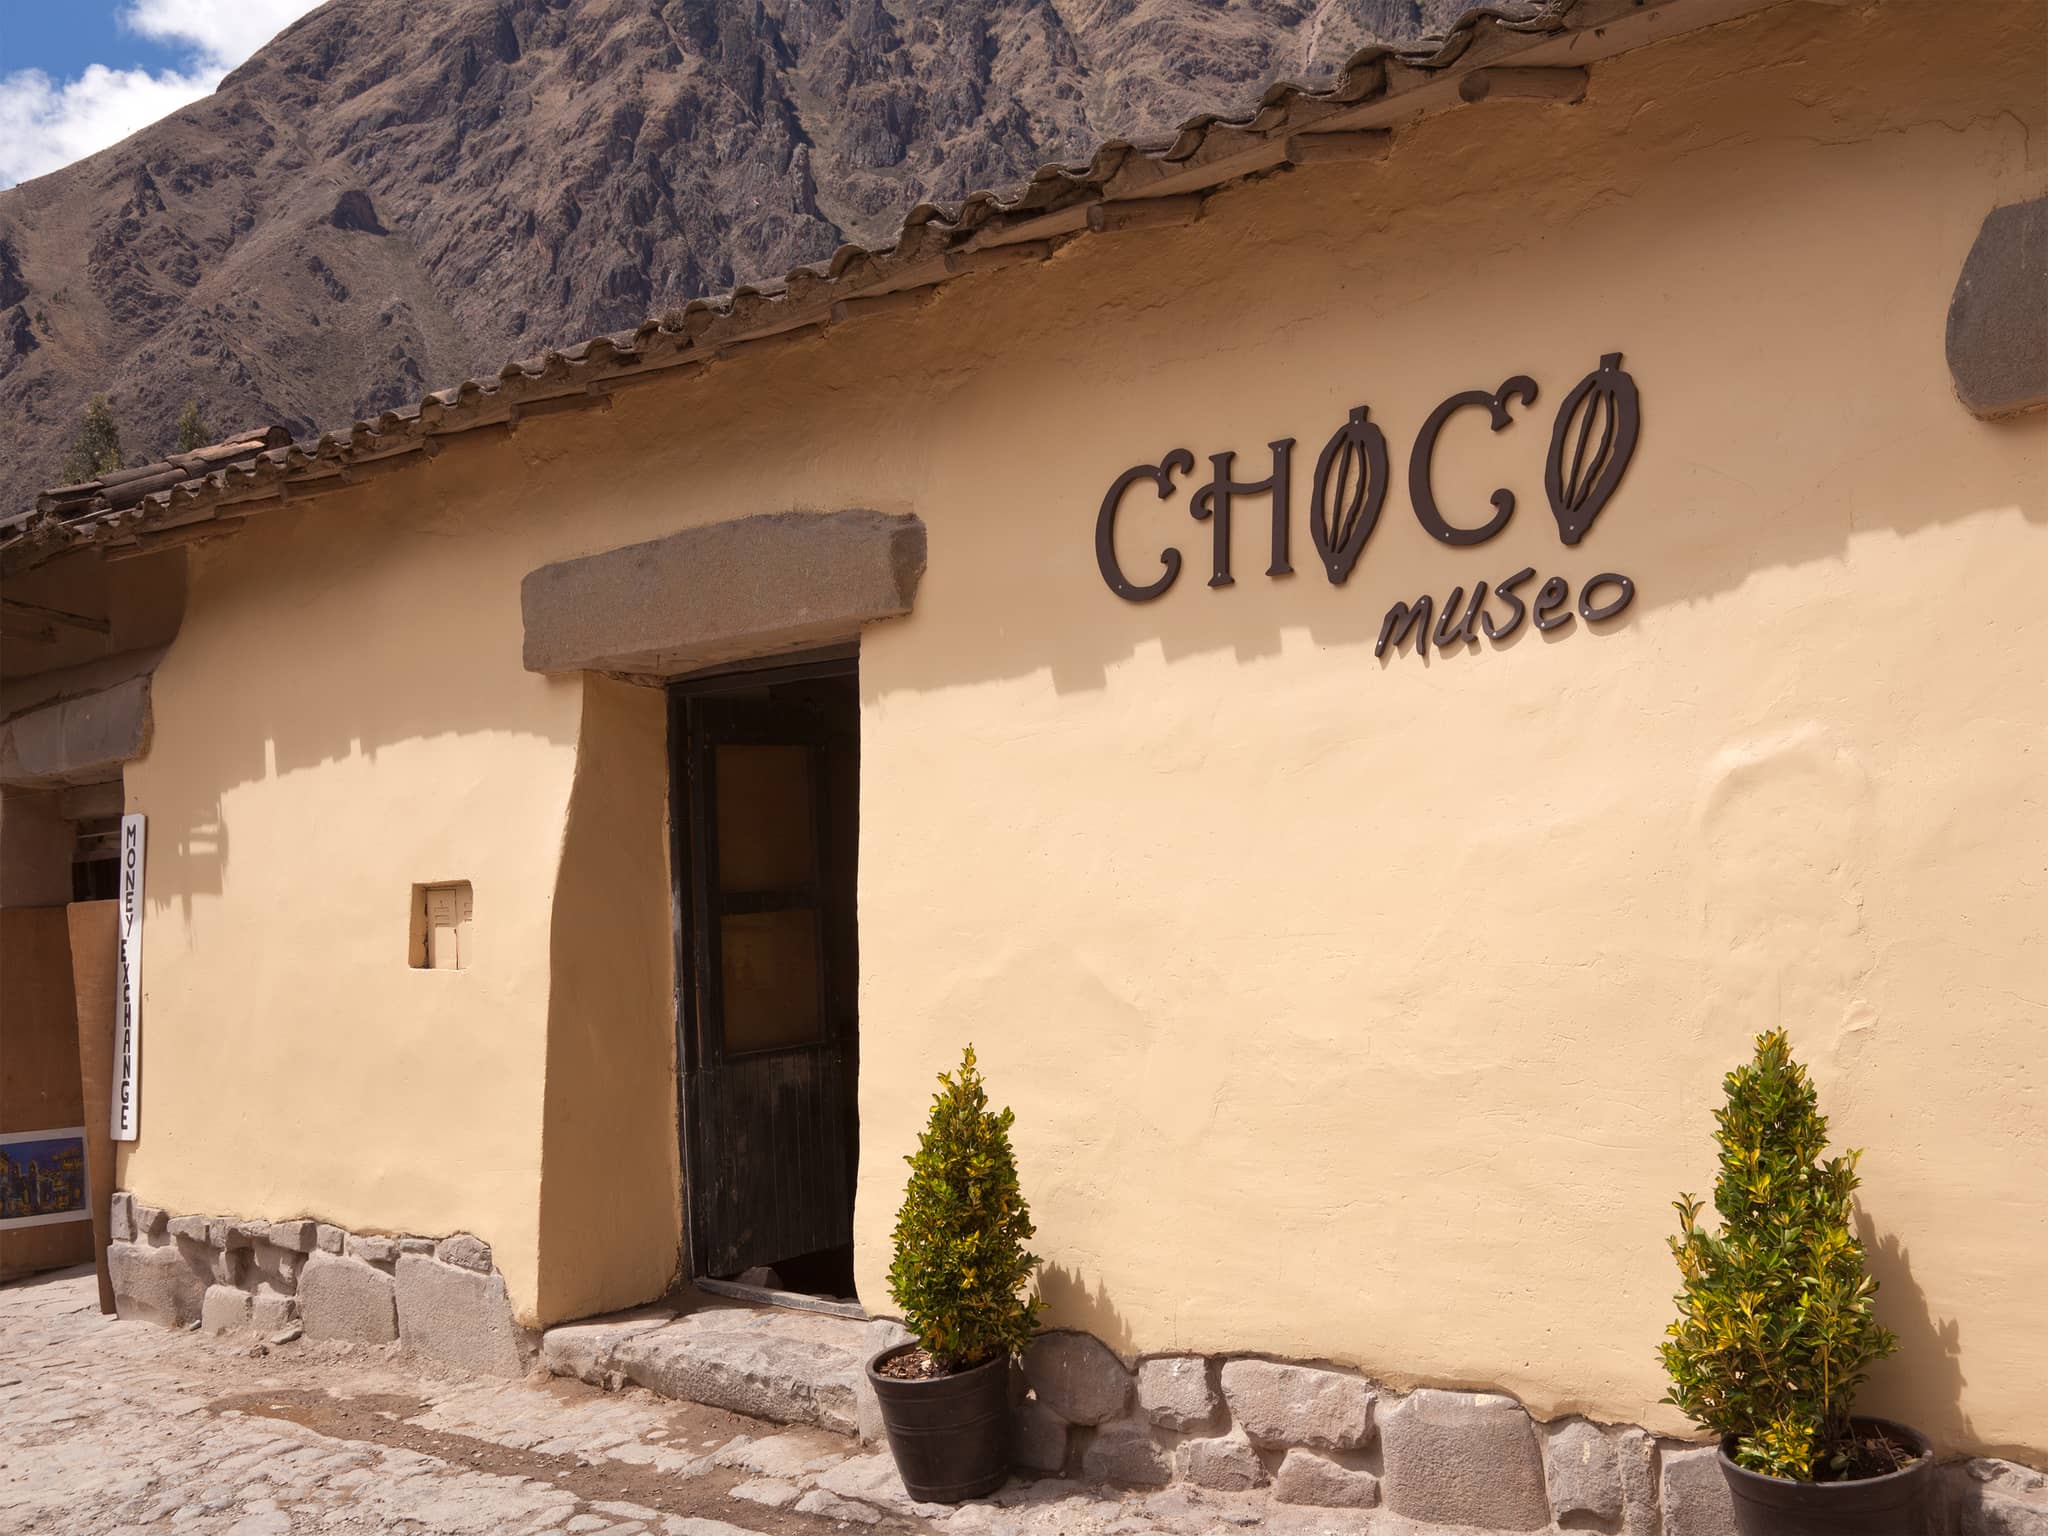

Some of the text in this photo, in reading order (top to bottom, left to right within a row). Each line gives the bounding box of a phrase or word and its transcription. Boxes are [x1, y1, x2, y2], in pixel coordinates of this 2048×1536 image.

[1095, 351, 1642, 605] CHOCO
[120, 823, 137, 1131] MONEY EXCHANGE
